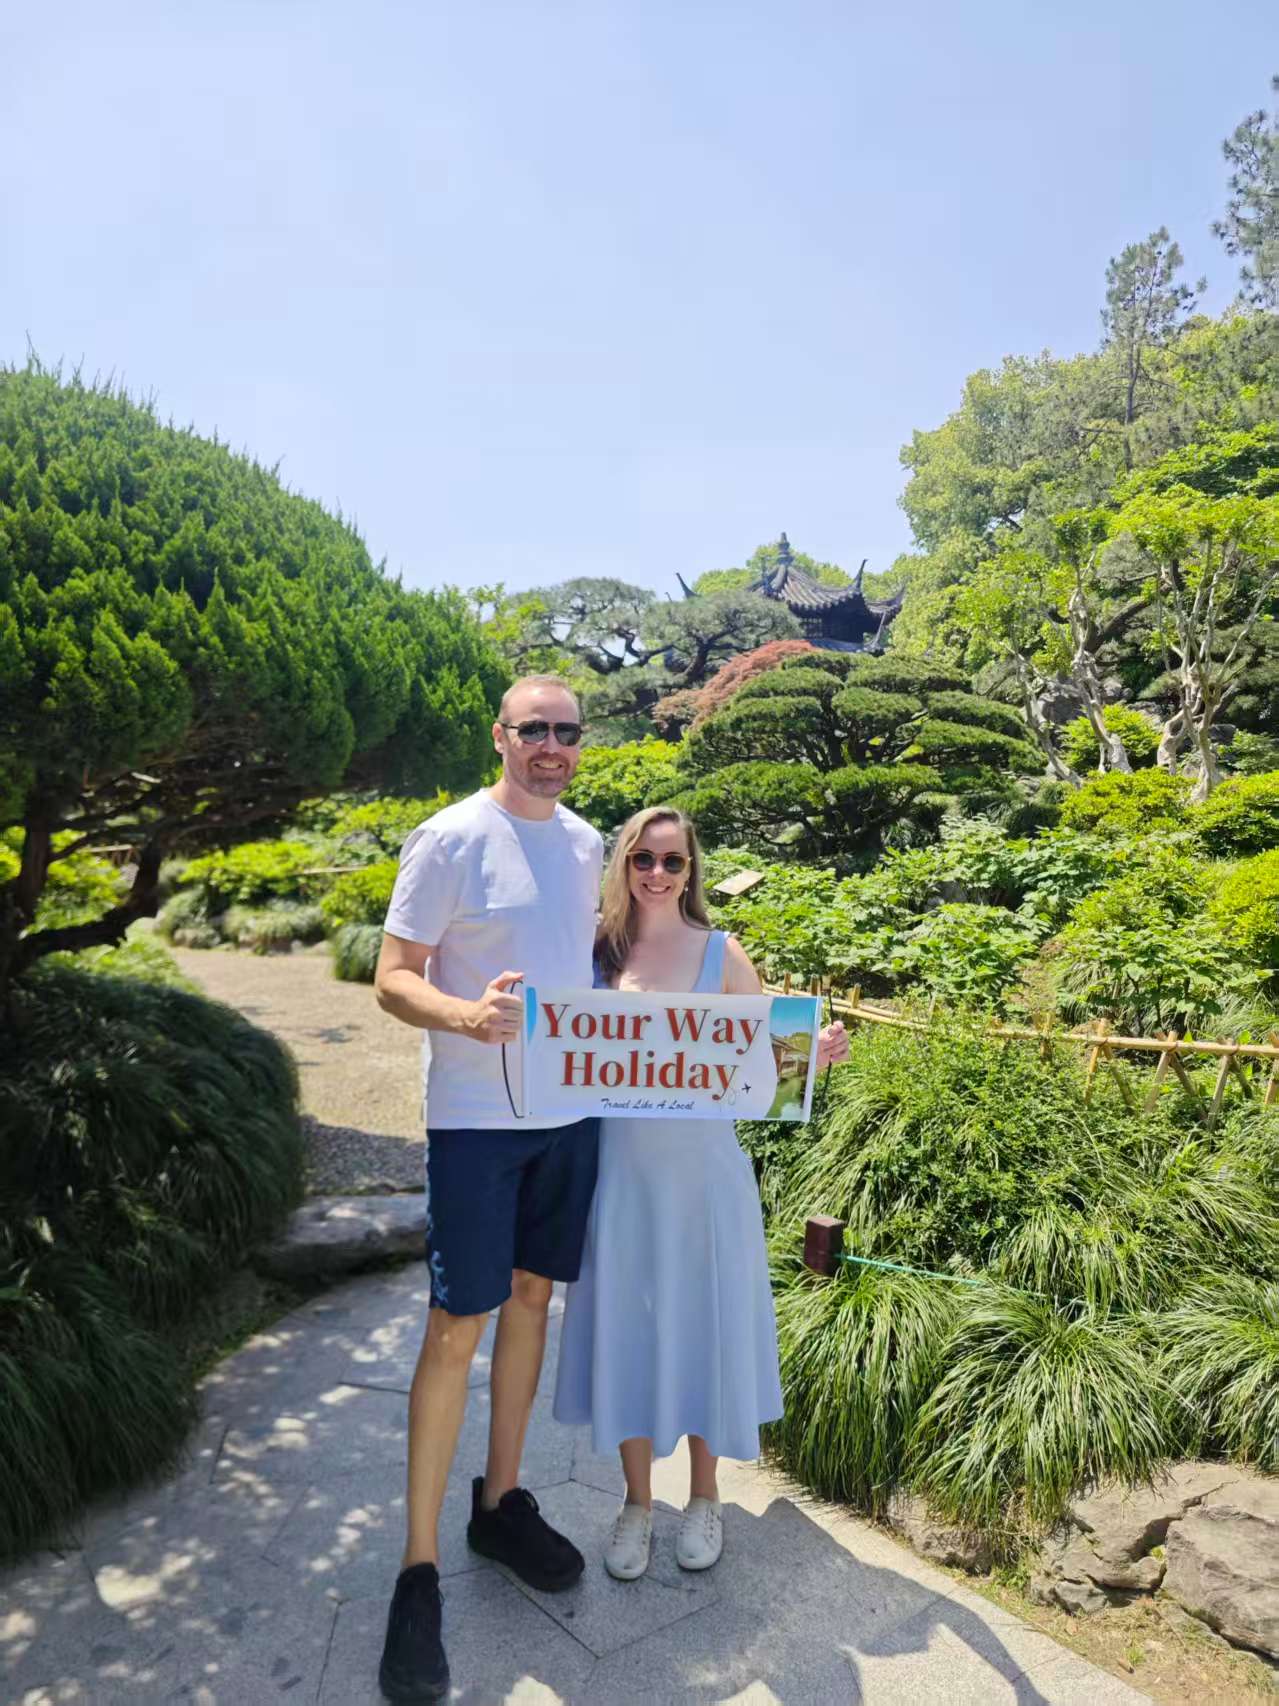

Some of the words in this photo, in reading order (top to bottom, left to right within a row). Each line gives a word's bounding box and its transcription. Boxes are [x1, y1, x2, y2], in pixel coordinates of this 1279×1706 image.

[541, 1003, 653, 1041] Your
[664, 1007, 764, 1055] Way
[560, 1050, 739, 1101] Holiday
[600, 1098, 631, 1111] Travel
[632, 1099, 653, 1110] Like
[656, 1100, 667, 1110] A
[668, 1099, 695, 1110] Local
